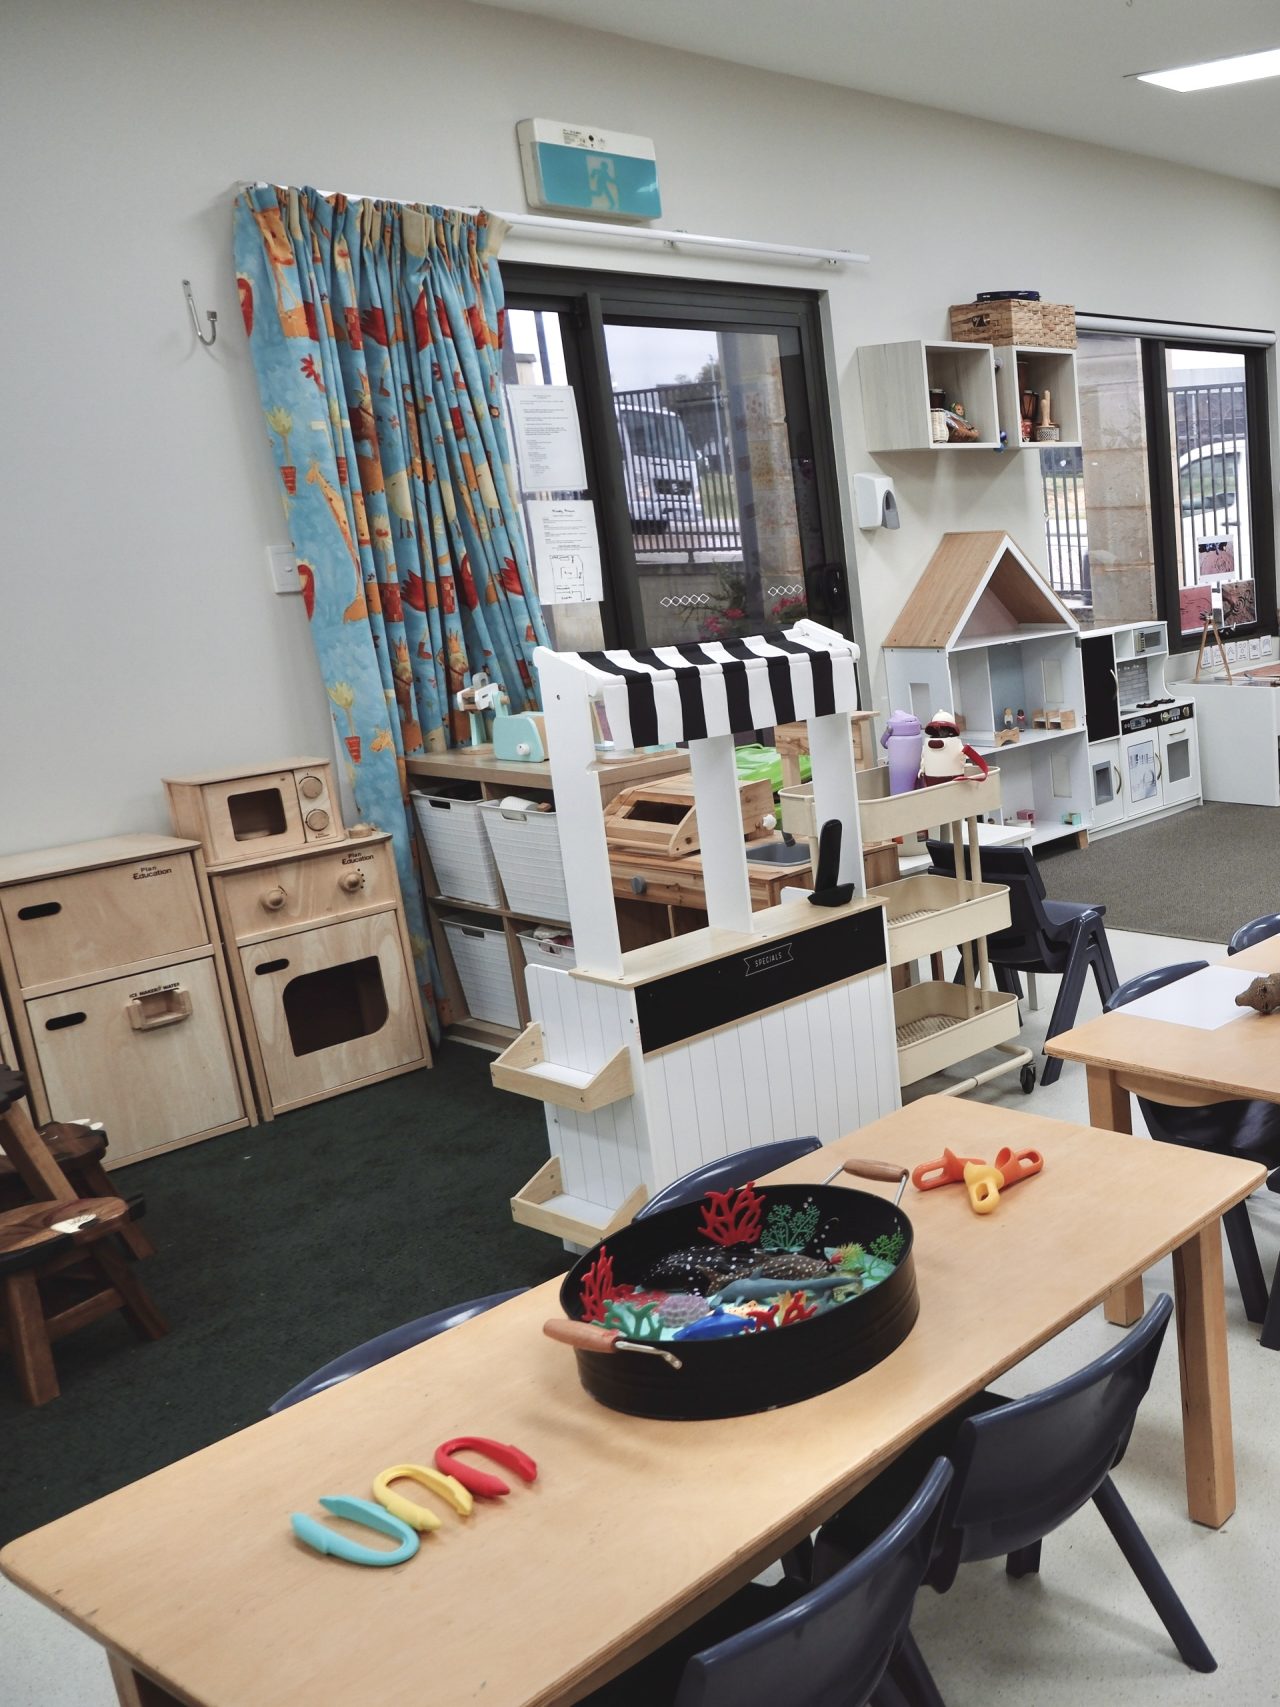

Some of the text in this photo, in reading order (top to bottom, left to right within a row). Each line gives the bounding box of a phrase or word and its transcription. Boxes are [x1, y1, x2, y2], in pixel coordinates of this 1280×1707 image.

[341, 854, 374, 865] Education
[132, 868, 172, 880] Education
[754, 951, 783, 968] SPECIALS
